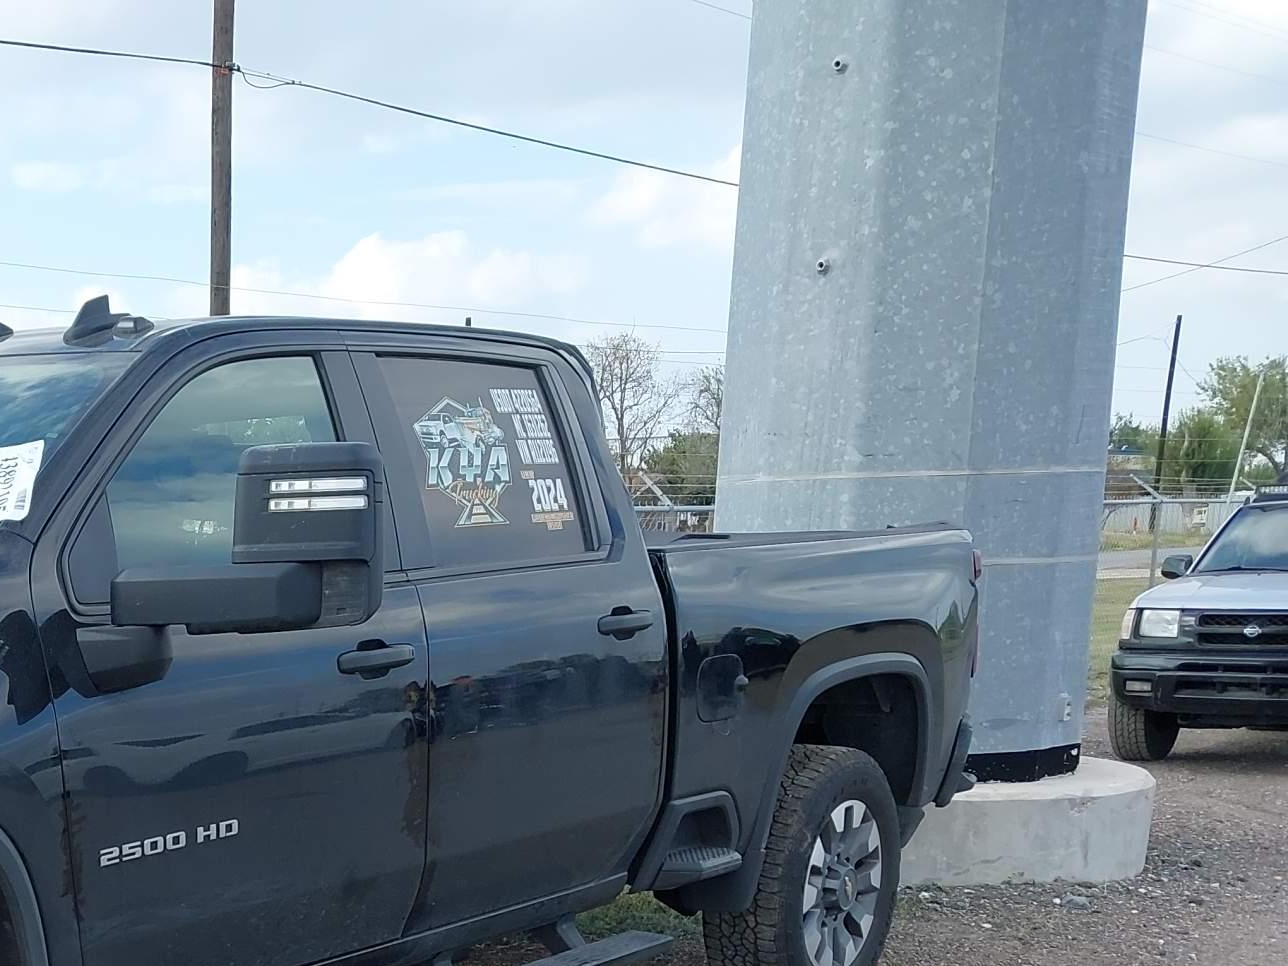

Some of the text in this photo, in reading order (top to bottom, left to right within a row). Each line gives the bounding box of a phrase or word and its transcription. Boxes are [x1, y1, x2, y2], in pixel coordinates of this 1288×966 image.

[528, 479, 568, 512] 2024
[100, 819, 239, 867] 2500 HD
